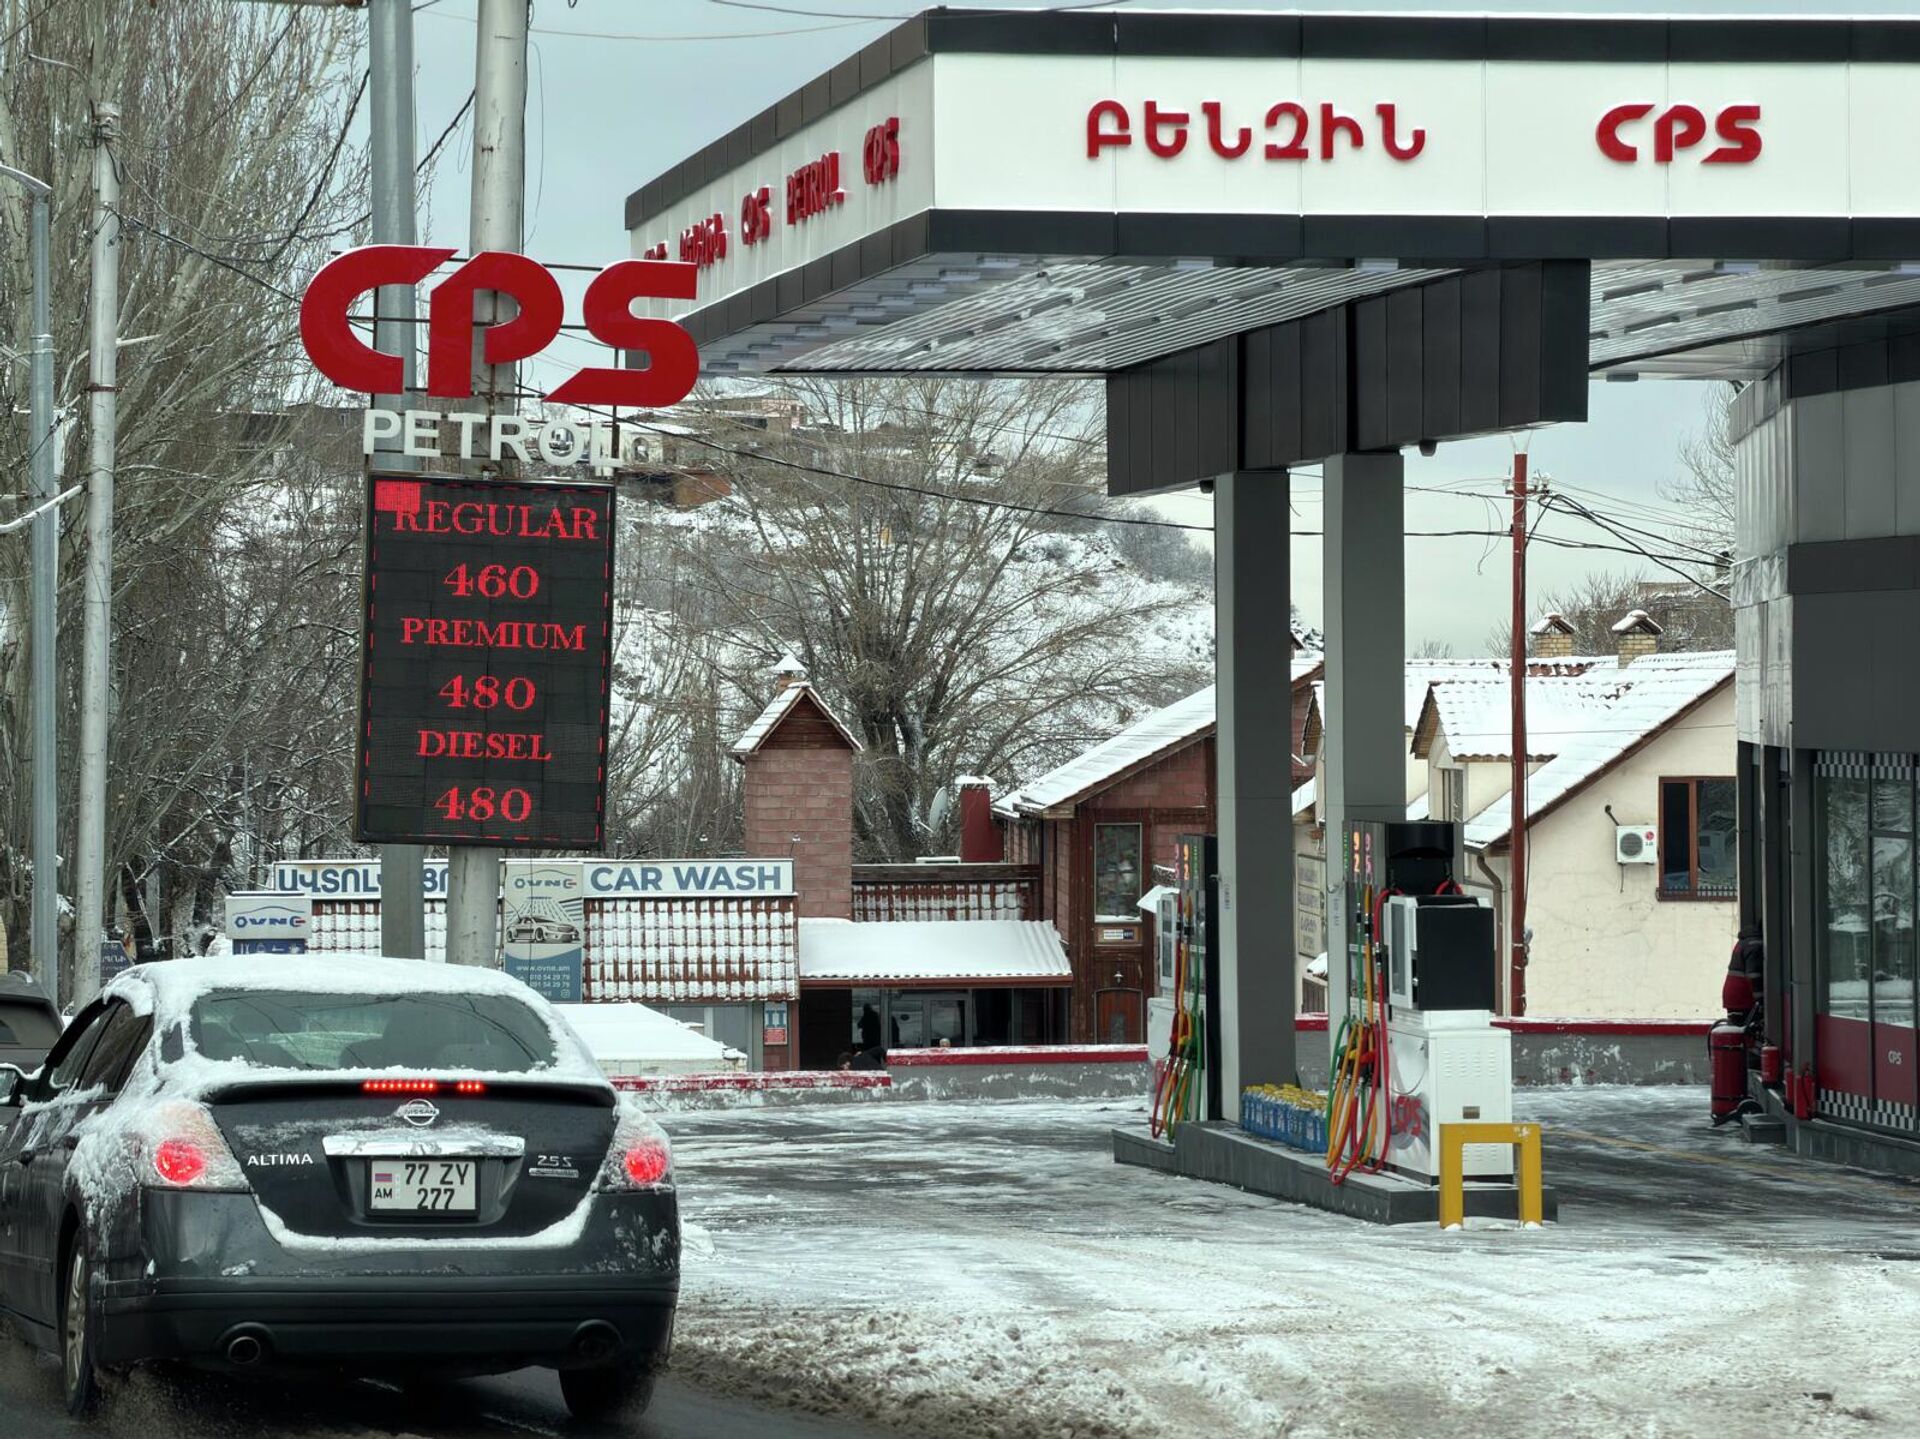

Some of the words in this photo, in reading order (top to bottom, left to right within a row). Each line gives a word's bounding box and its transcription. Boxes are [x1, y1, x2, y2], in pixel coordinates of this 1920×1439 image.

[1087, 99, 1426, 161] ԲԵՆԶԻՆ
[1595, 103, 1762, 163] CPS
[786, 151, 845, 226] PETROL
[301, 245, 700, 408] CPS
[363, 409, 624, 477] PETROL
[392, 500, 600, 540] REGULAR
[443, 562, 540, 599] 460
[401, 617, 587, 651] PREMIUM
[438, 674, 537, 711] 480
[416, 729, 553, 761] DIESEL
[433, 785, 533, 822] 480
[590, 867, 664, 892] CAR
[672, 866, 782, 891] WASH
[247, 1153, 314, 1166] ALTIMA
[405, 1163, 429, 1185] 77
[440, 1163, 469, 1185] ZY
[375, 1187, 393, 1199] AM
[417, 1187, 455, 1209] 277
